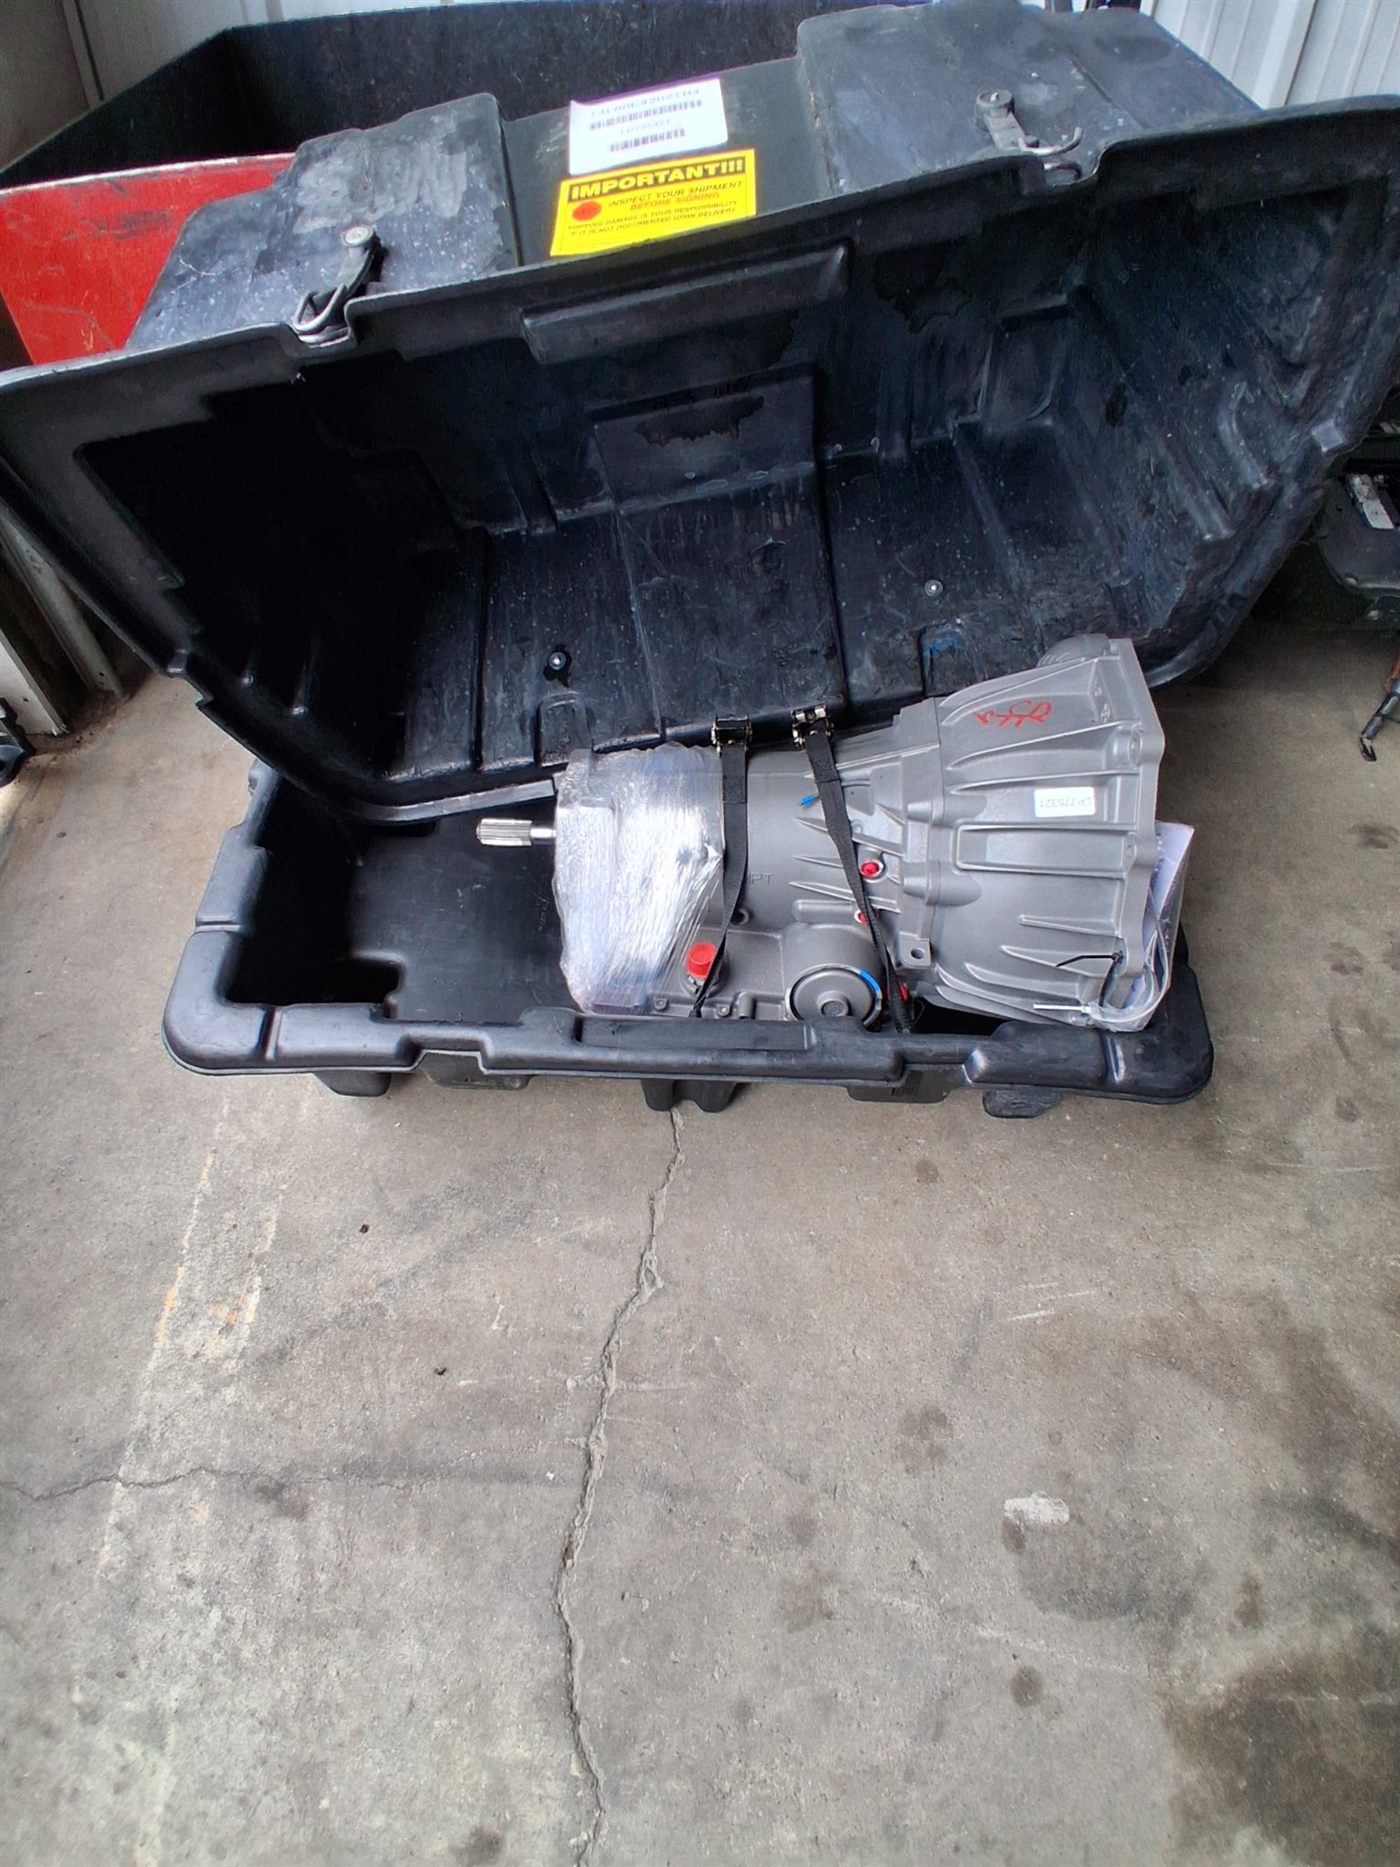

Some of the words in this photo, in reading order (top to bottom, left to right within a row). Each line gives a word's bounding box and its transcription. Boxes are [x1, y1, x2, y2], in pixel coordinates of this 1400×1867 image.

[570, 159, 744, 200] IMPORTANT!!!
[608, 192, 653, 208] INSPECT
[657, 188, 685, 199] YOUR
[689, 180, 743, 195] SHIPMENT
[630, 198, 673, 211] BEFORE
[676, 191, 720, 204] SIGNING
[606, 215, 639, 225] DAMAGE
[651, 209, 672, 217] YOUR
[616, 216, 671, 231] DOCUMENTED
[673, 212, 696, 221] UPON
[698, 208, 736, 218] DELIVERY
